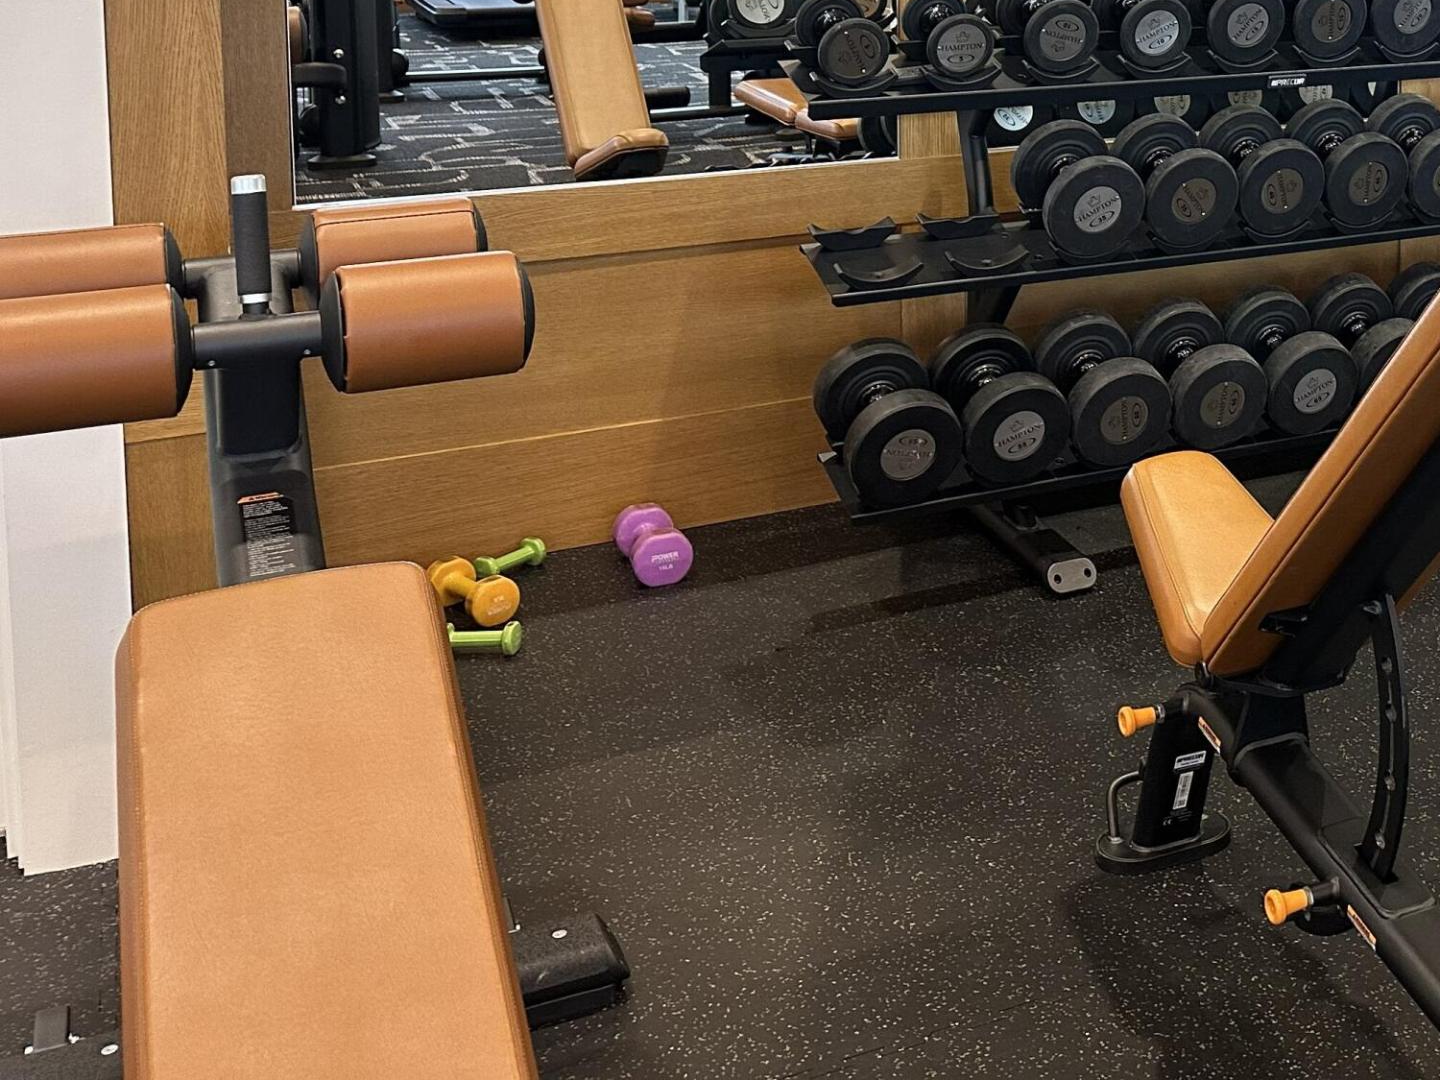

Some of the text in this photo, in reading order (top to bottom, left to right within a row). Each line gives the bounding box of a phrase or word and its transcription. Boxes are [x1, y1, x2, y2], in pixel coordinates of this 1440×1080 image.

[1139, 22, 1176, 43] HAMPTON
[1234, 9, 1261, 39] HAMPTON
[941, 43, 982, 52] HAMPTON
[1046, 30, 1081, 44] HAMPTON
[1078, 197, 1118, 222] HAMPTON
[1297, 379, 1335, 401] HAMPTON
[998, 424, 1041, 448] HAMPTON
